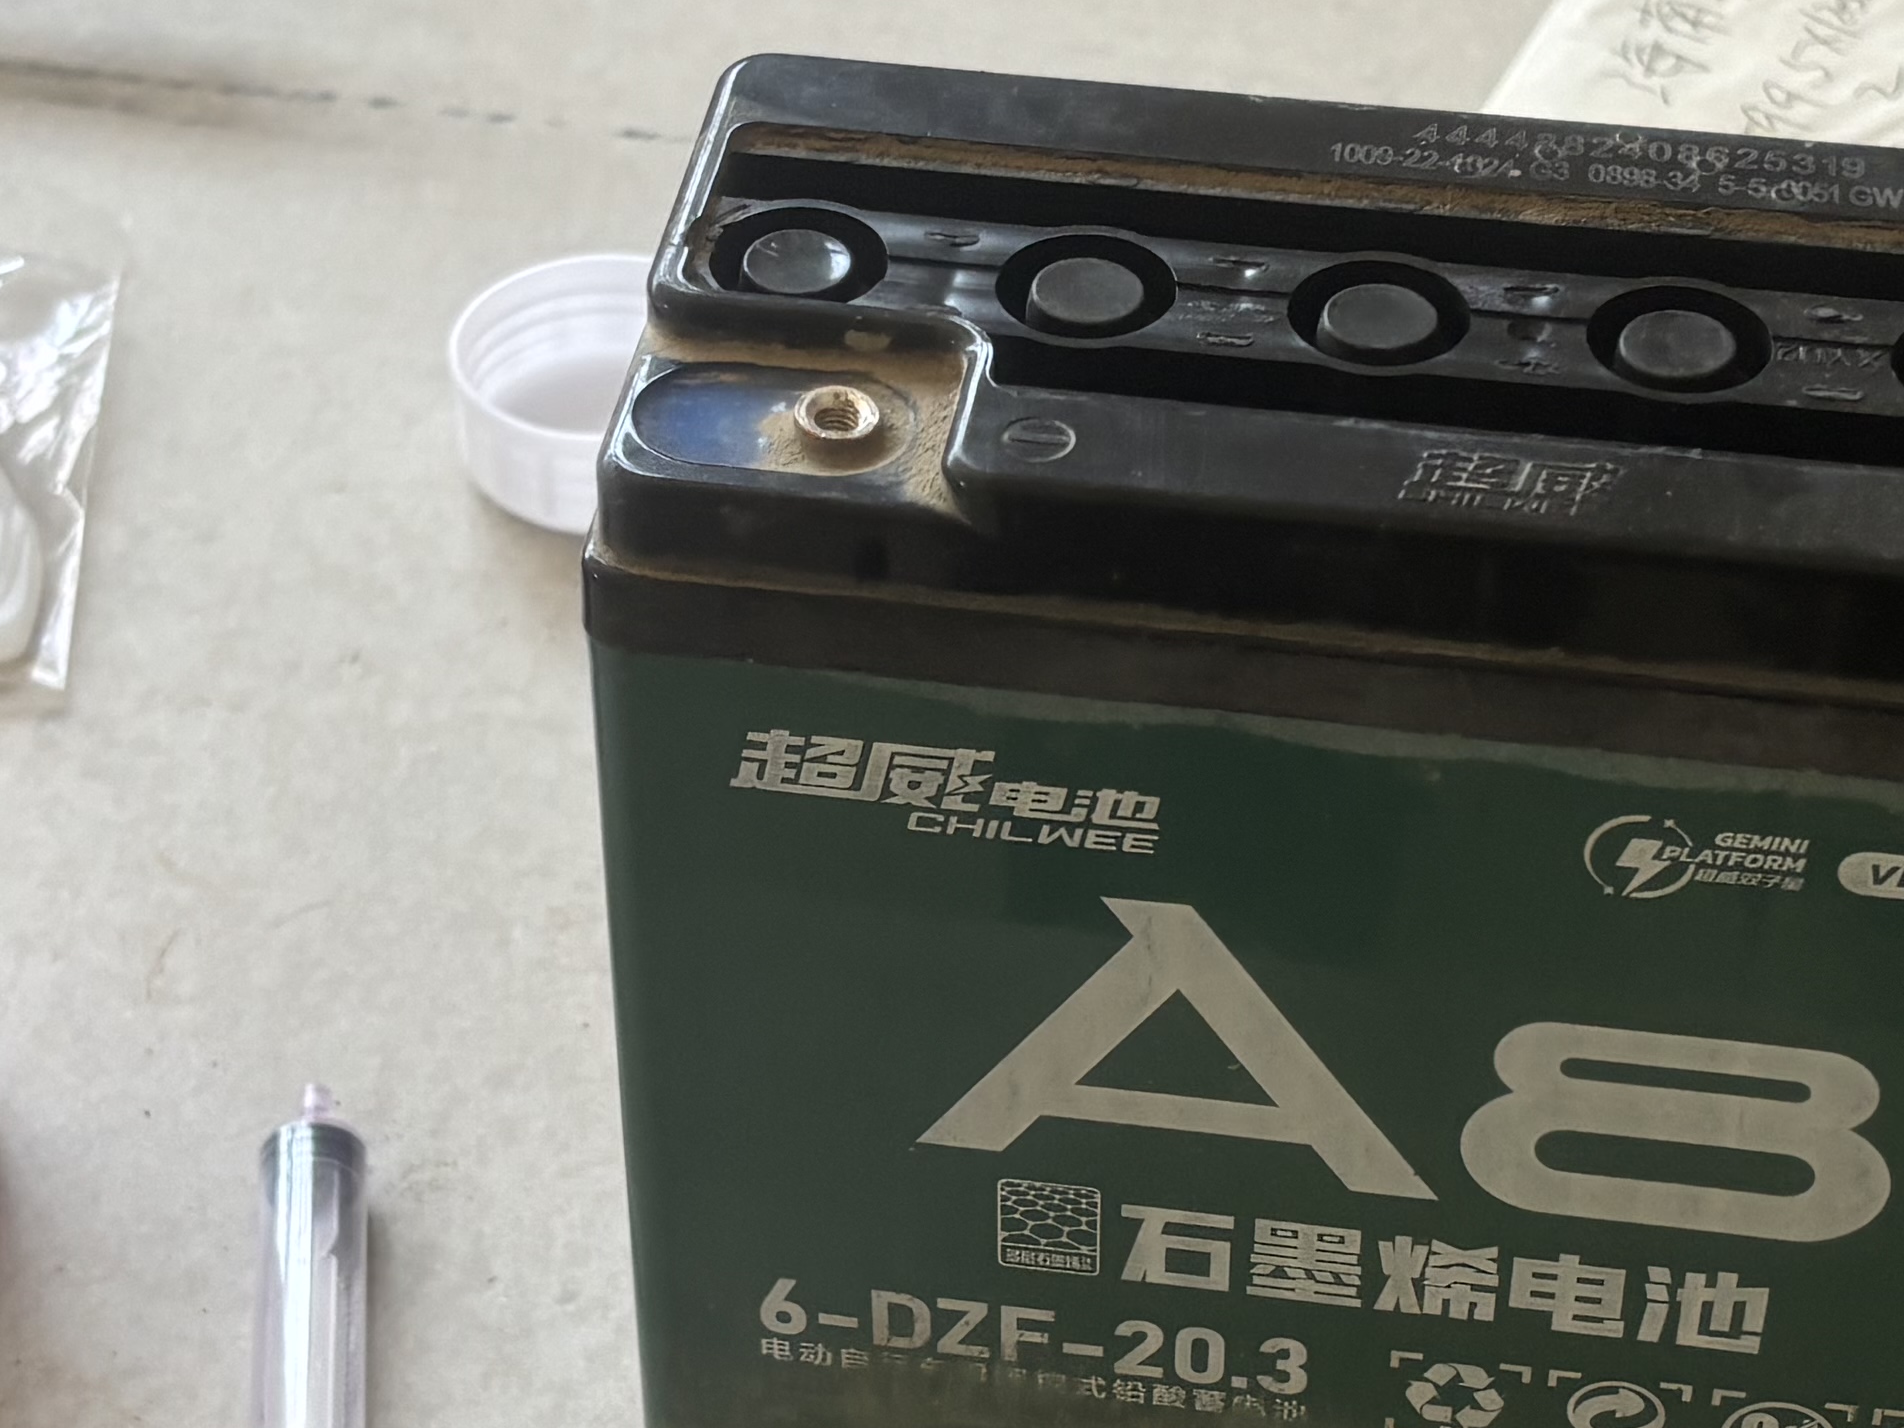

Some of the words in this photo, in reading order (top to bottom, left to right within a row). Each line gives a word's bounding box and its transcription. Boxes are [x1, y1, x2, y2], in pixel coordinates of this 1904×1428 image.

[1848, 183, 1904, 210] GW
[906, 811, 1161, 855] CHILWEE
[1714, 831, 1811, 854] GEMINI
[1661, 844, 1807, 874] PLATFORM
[914, 895, 1891, 1243] A8
[1119, 1202, 1771, 1355] 石墨烯电池
[758, 1277, 1310, 1396] 6-DZF-20.3
